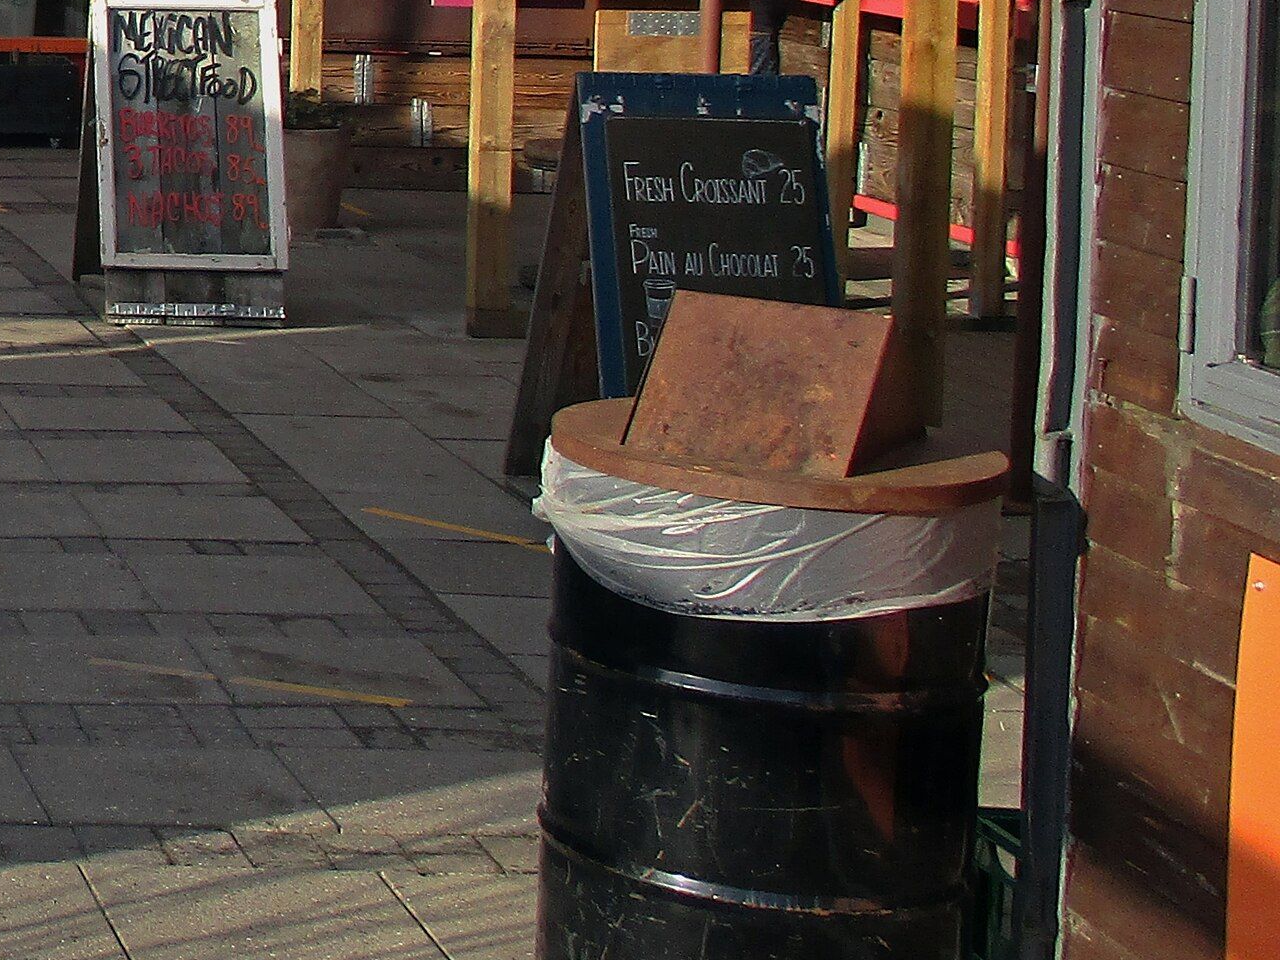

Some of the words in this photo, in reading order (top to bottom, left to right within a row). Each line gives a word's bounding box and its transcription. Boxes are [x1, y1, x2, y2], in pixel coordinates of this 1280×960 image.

[123, 143, 143, 179] 3
[622, 161, 675, 203] FRESH
[679, 161, 768, 205] CROISSANT
[778, 169, 806, 205] 25
[629, 223, 659, 239] FRESH
[630, 239, 676, 276] PAIN
[684, 251, 705, 276] AU
[708, 242, 780, 278] CHOCOLAT
[789, 245, 816, 279] 25
